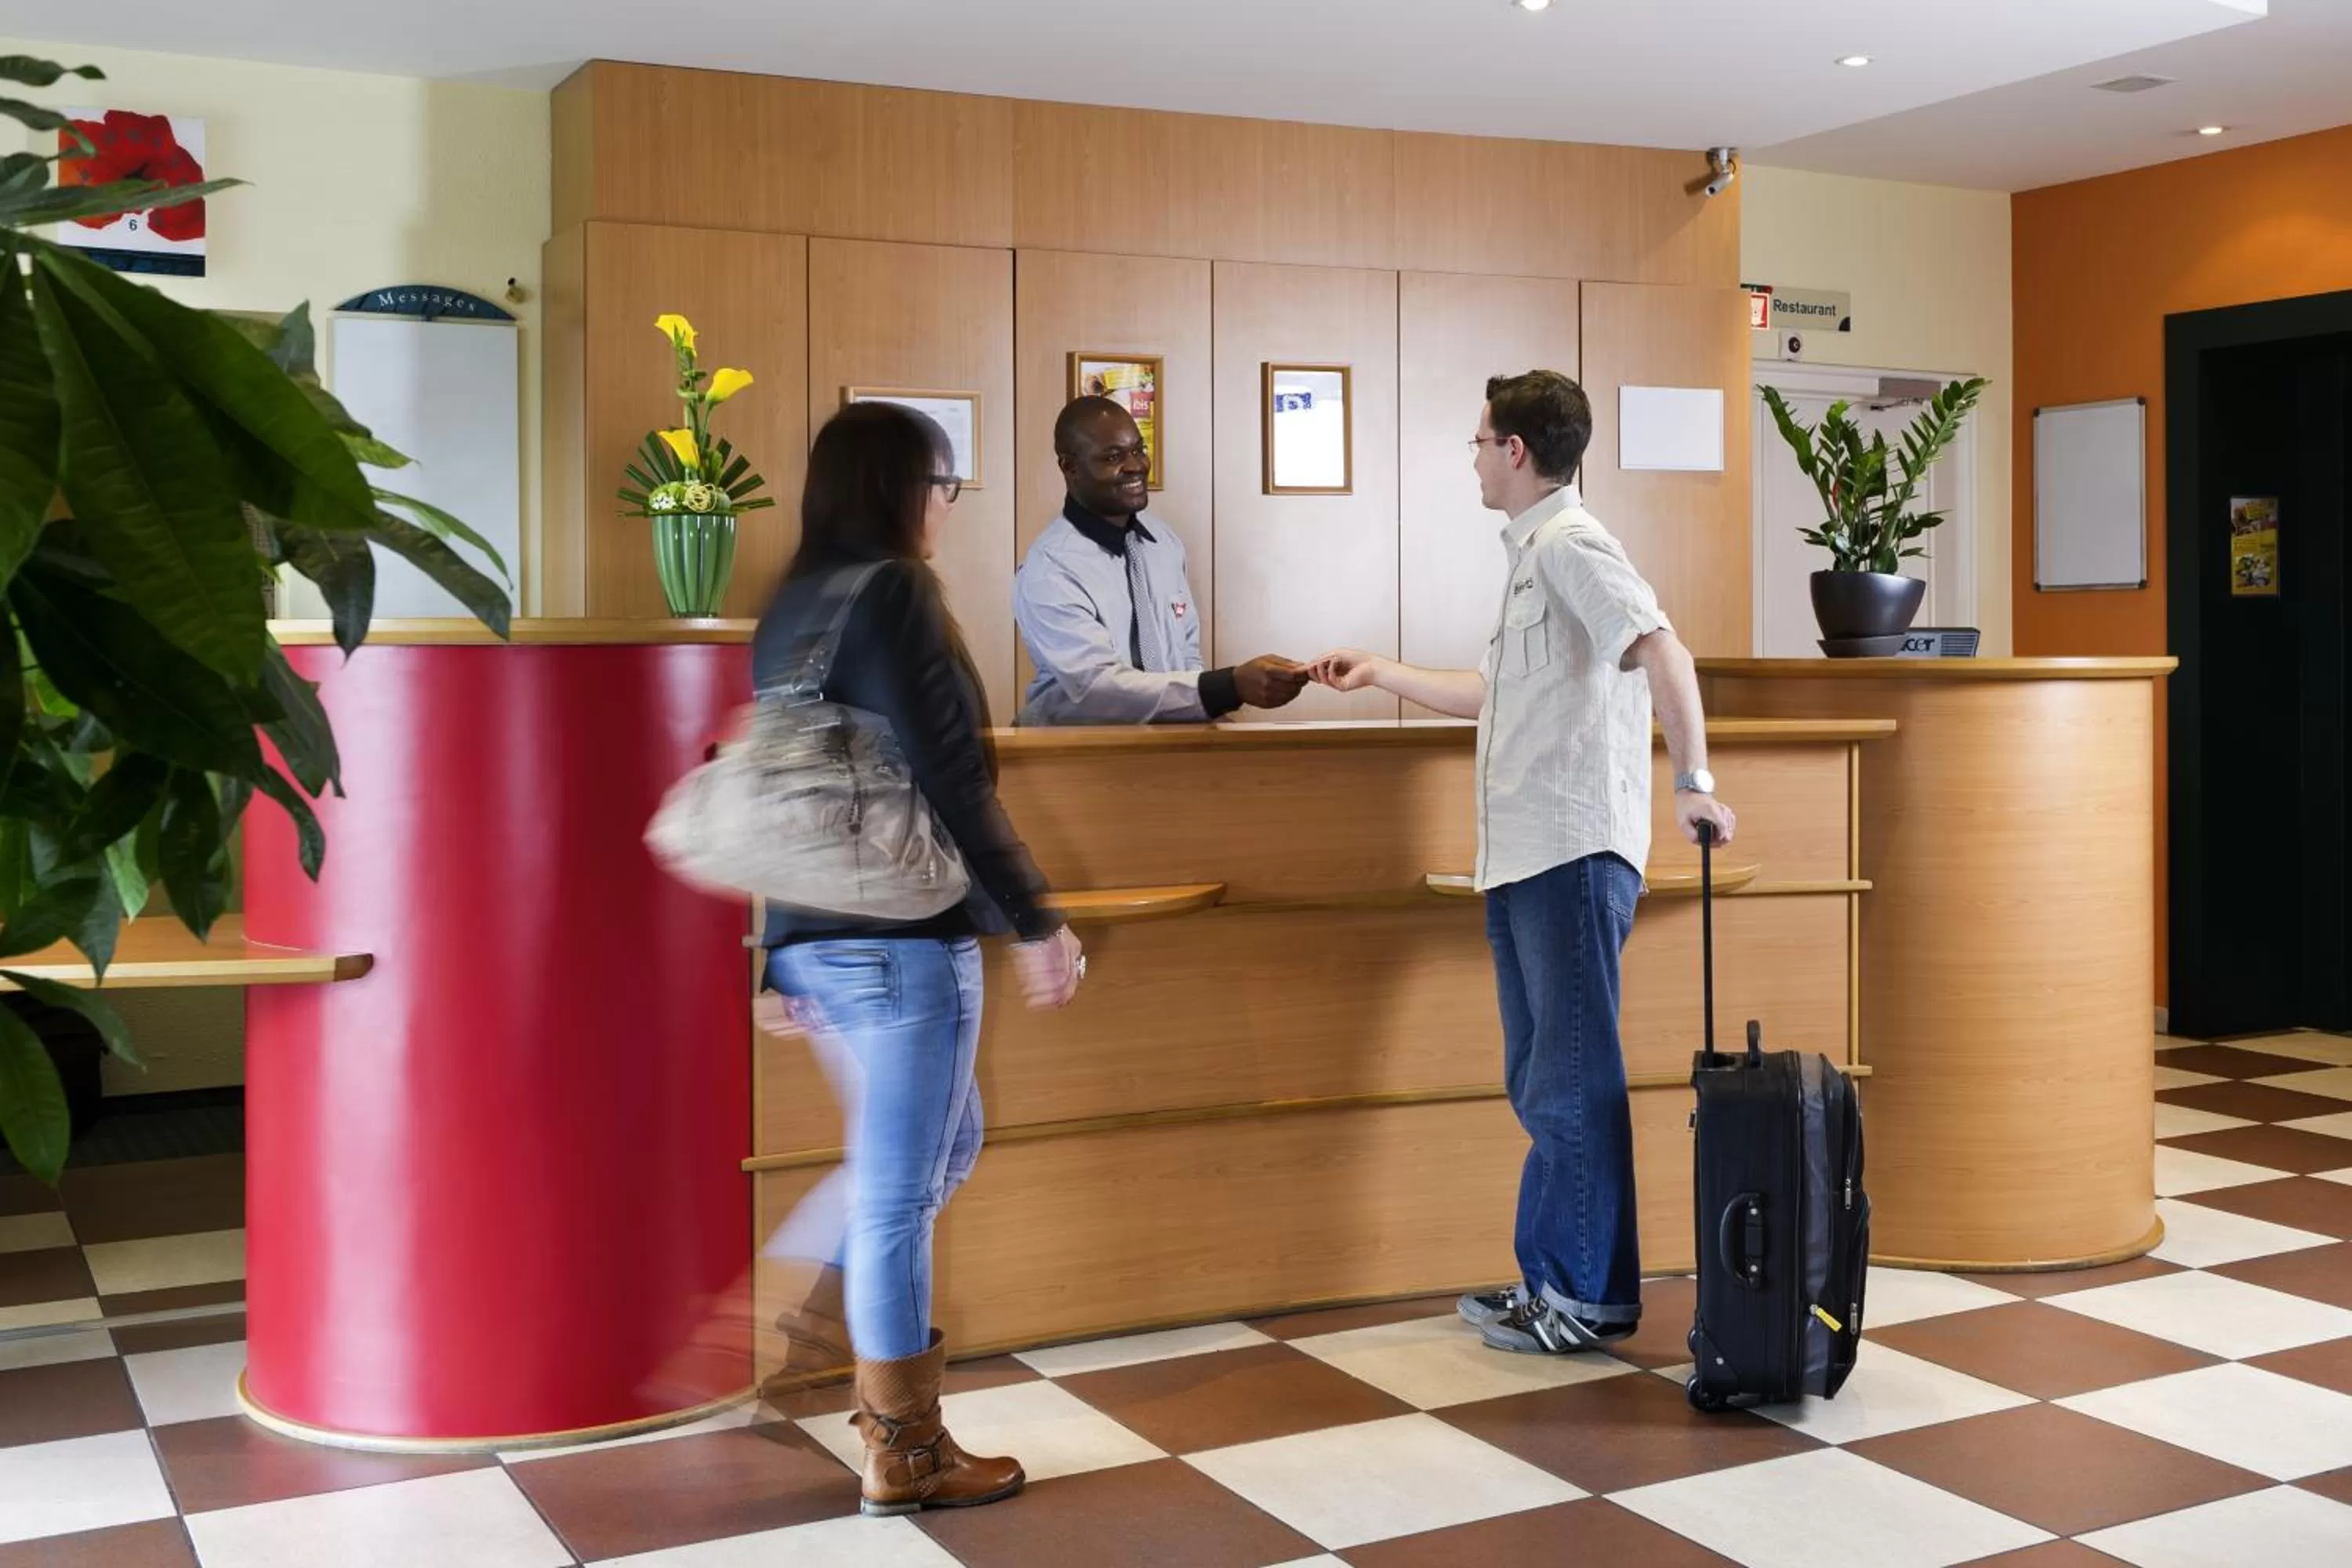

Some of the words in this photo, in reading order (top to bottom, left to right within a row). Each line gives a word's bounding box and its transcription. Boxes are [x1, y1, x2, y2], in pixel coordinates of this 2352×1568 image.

[129, 220, 137, 231] 6
[377, 292, 476, 312] Messages
[1773, 299, 1837, 317] Restaurant
